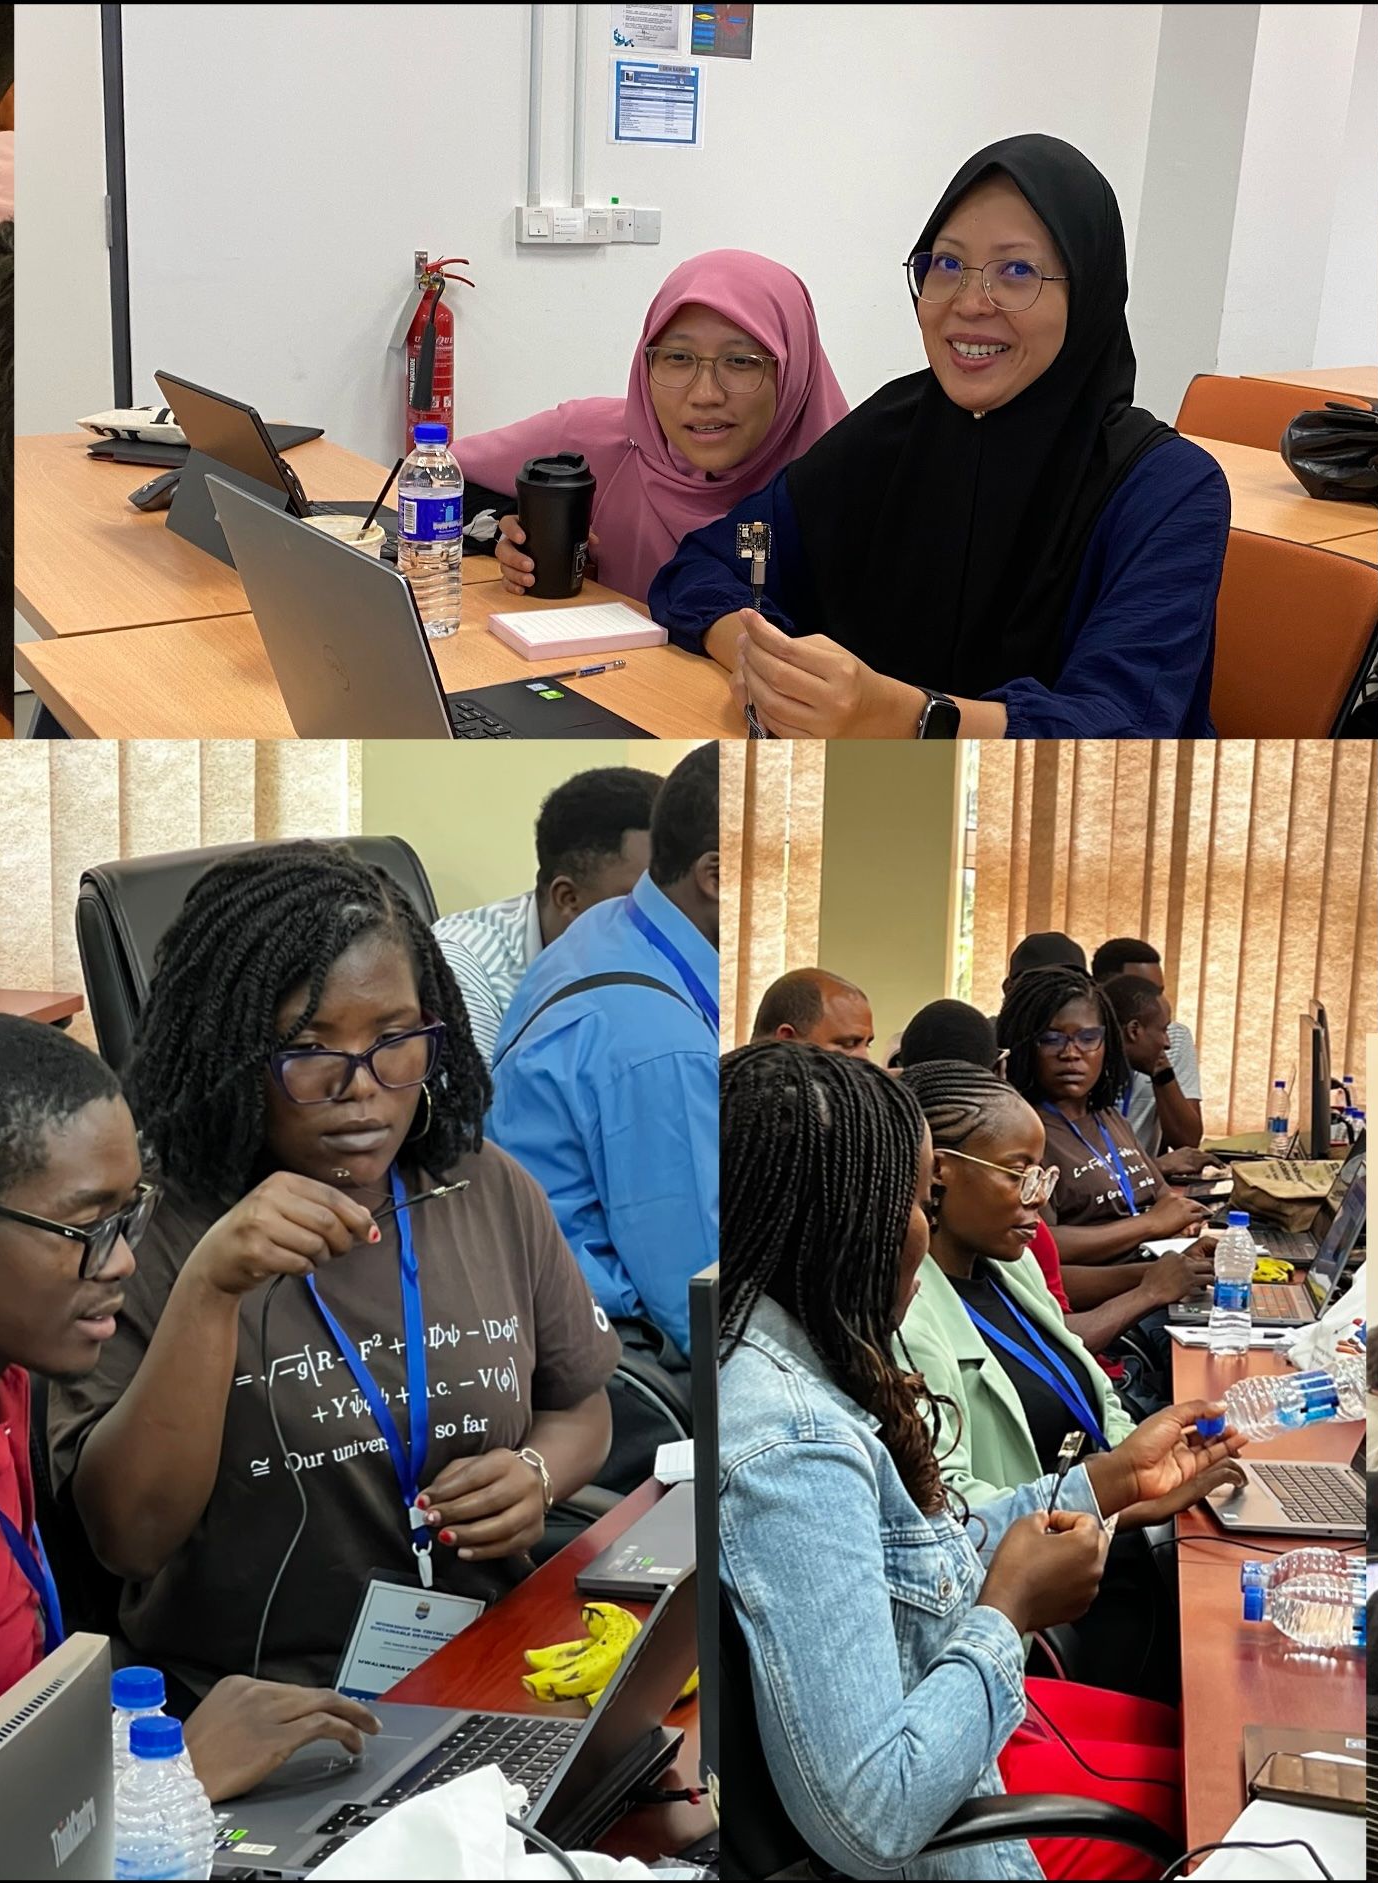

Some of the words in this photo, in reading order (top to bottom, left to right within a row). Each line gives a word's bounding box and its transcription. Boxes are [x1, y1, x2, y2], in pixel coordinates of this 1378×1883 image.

[415, 336, 453, 345] UQUE
[285, 1452, 325, 1473] Our
[332, 1438, 389, 1463] univer
[435, 1422, 456, 1440] so
[462, 1414, 488, 1434] far
[370, 1626, 411, 1637] SUSTAINABLE
